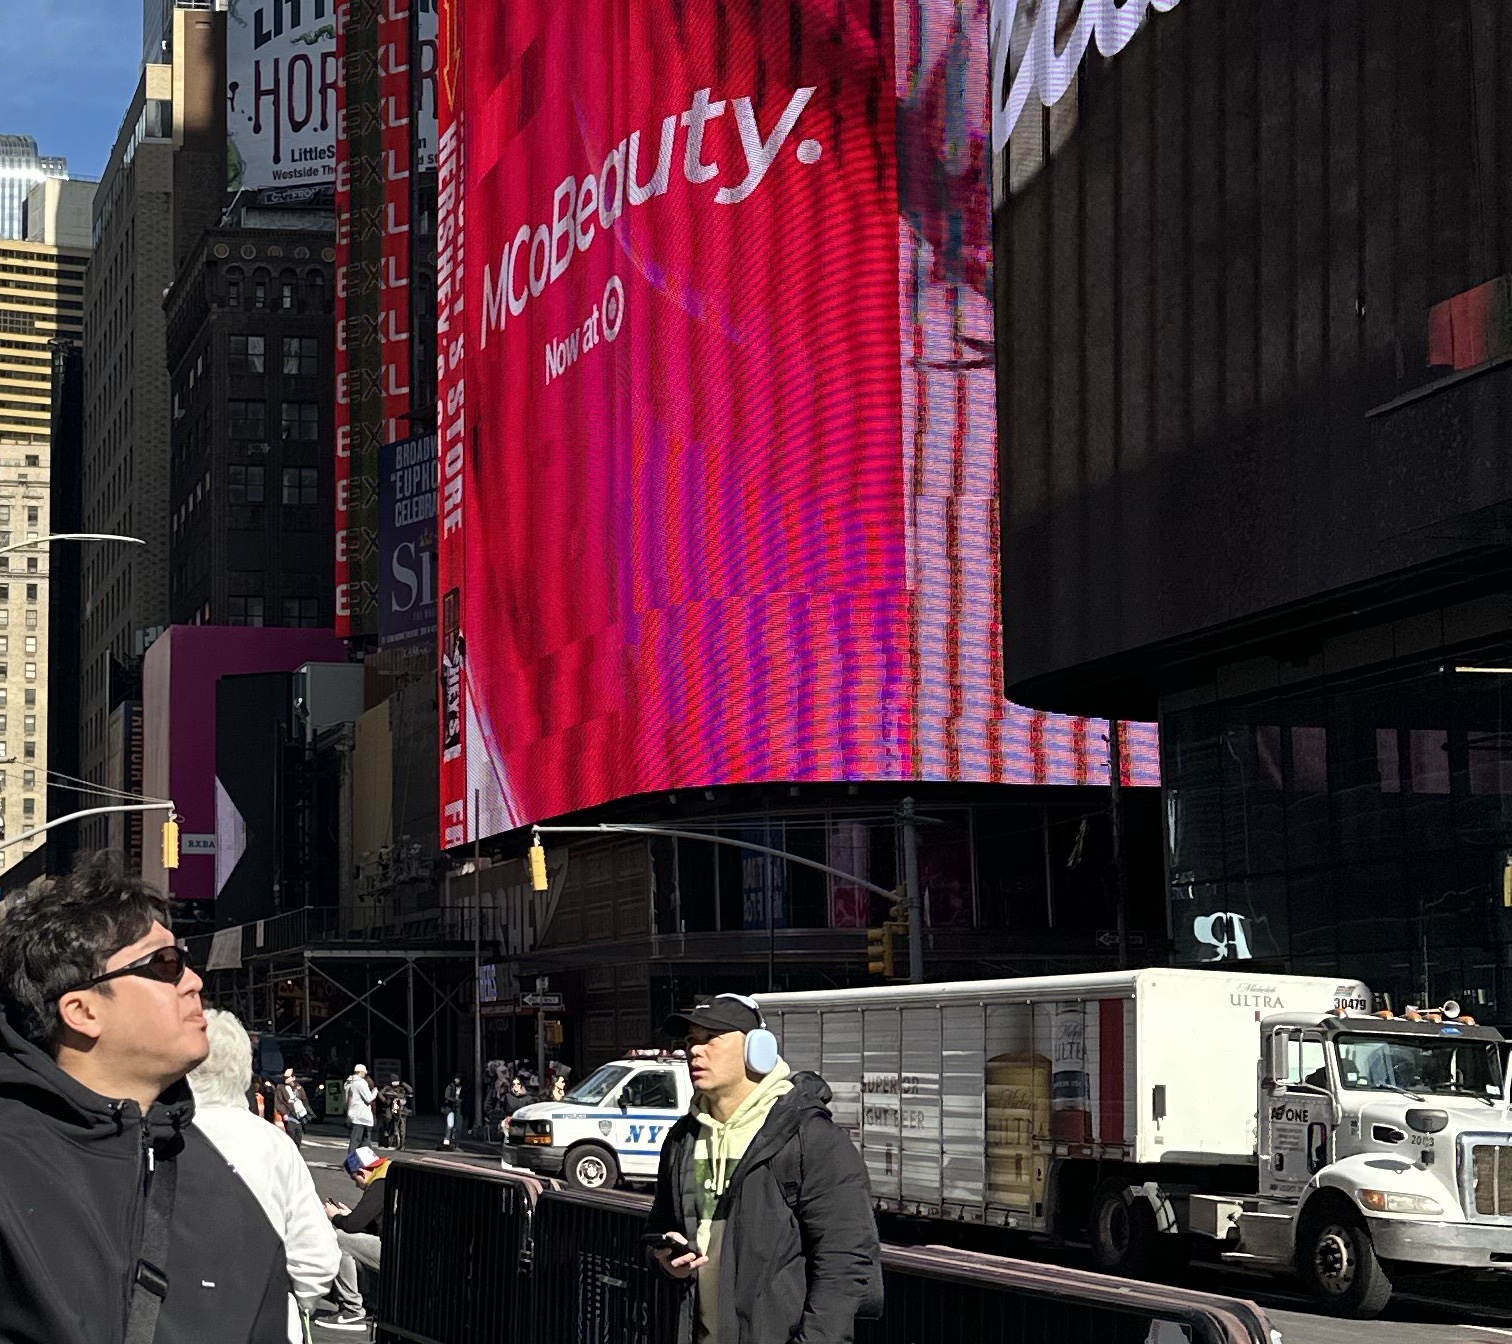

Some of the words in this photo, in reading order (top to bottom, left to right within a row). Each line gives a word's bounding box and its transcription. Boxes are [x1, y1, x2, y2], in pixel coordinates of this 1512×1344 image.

[272, 166, 319, 182] Westside
[545, 326, 580, 387] Now
[582, 303, 600, 354] at
[443, 378, 465, 541] STORE
[1230, 993, 1285, 1009] ULTRA
[861, 1075, 919, 1095] SUPEROR
[1285, 1109, 1309, 1123] ONE
[625, 1124, 668, 1144] NY
